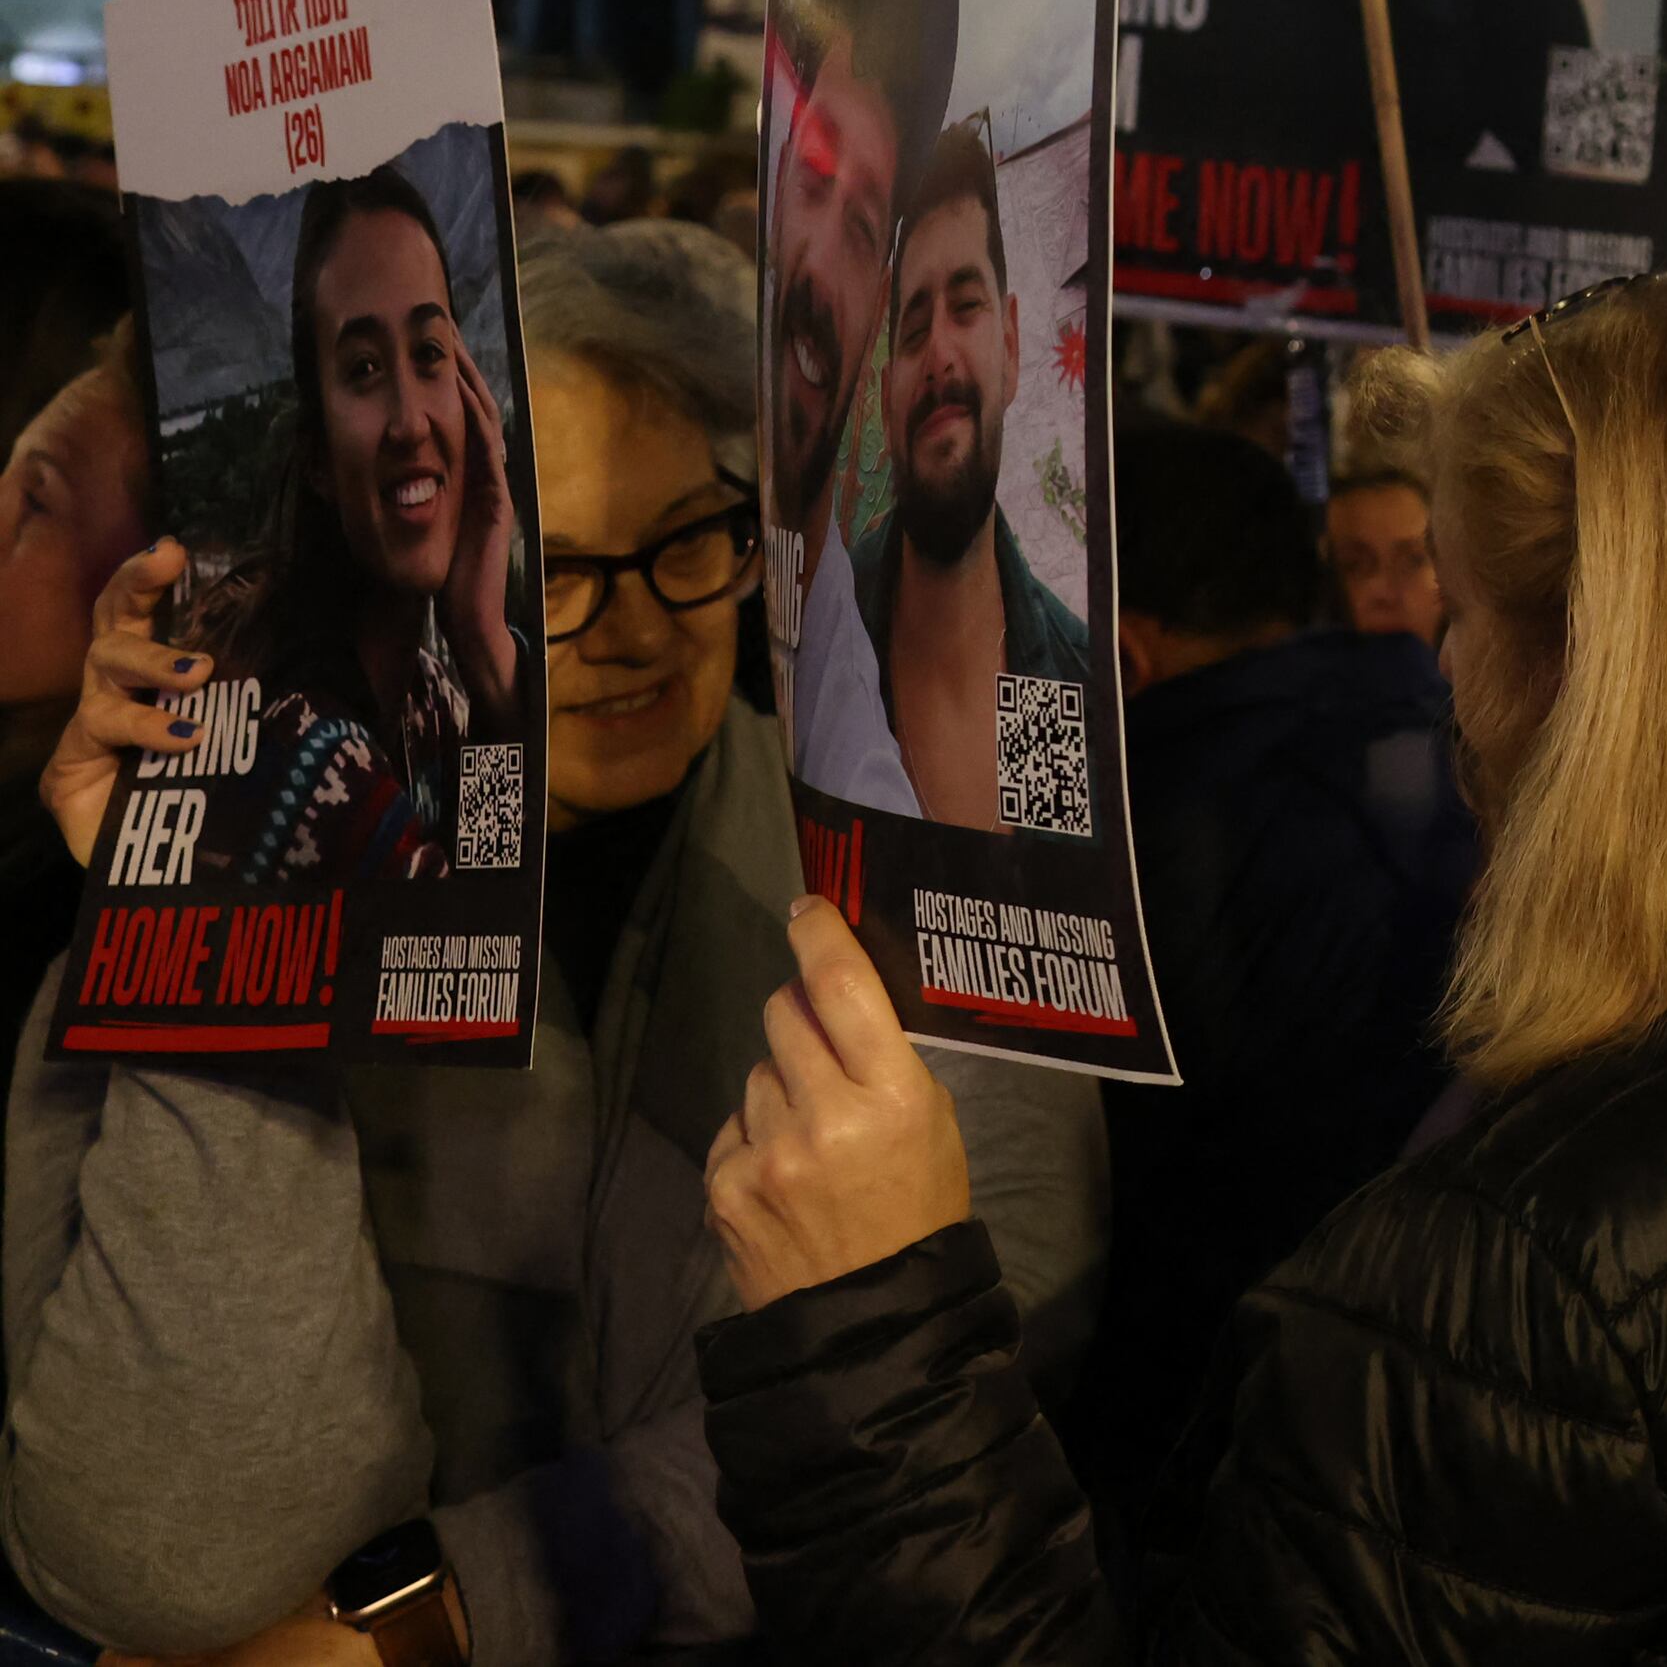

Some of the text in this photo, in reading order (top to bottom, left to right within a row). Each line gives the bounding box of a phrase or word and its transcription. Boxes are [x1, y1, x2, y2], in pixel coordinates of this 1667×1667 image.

[224, 26, 373, 117] NOA ARGAMANI
[284, 103, 325, 174] (26)
[107, 789, 207, 886] HER
[78, 888, 344, 1007] HOME NOW!
[381, 935, 521, 970] HOSTAGES AND MISSING
[914, 888, 1116, 961] HOSTAGES AND MISSING
[375, 971, 519, 1023] FAMILIES FORUM
[917, 931, 1129, 1022] FAMILIES FORUM
